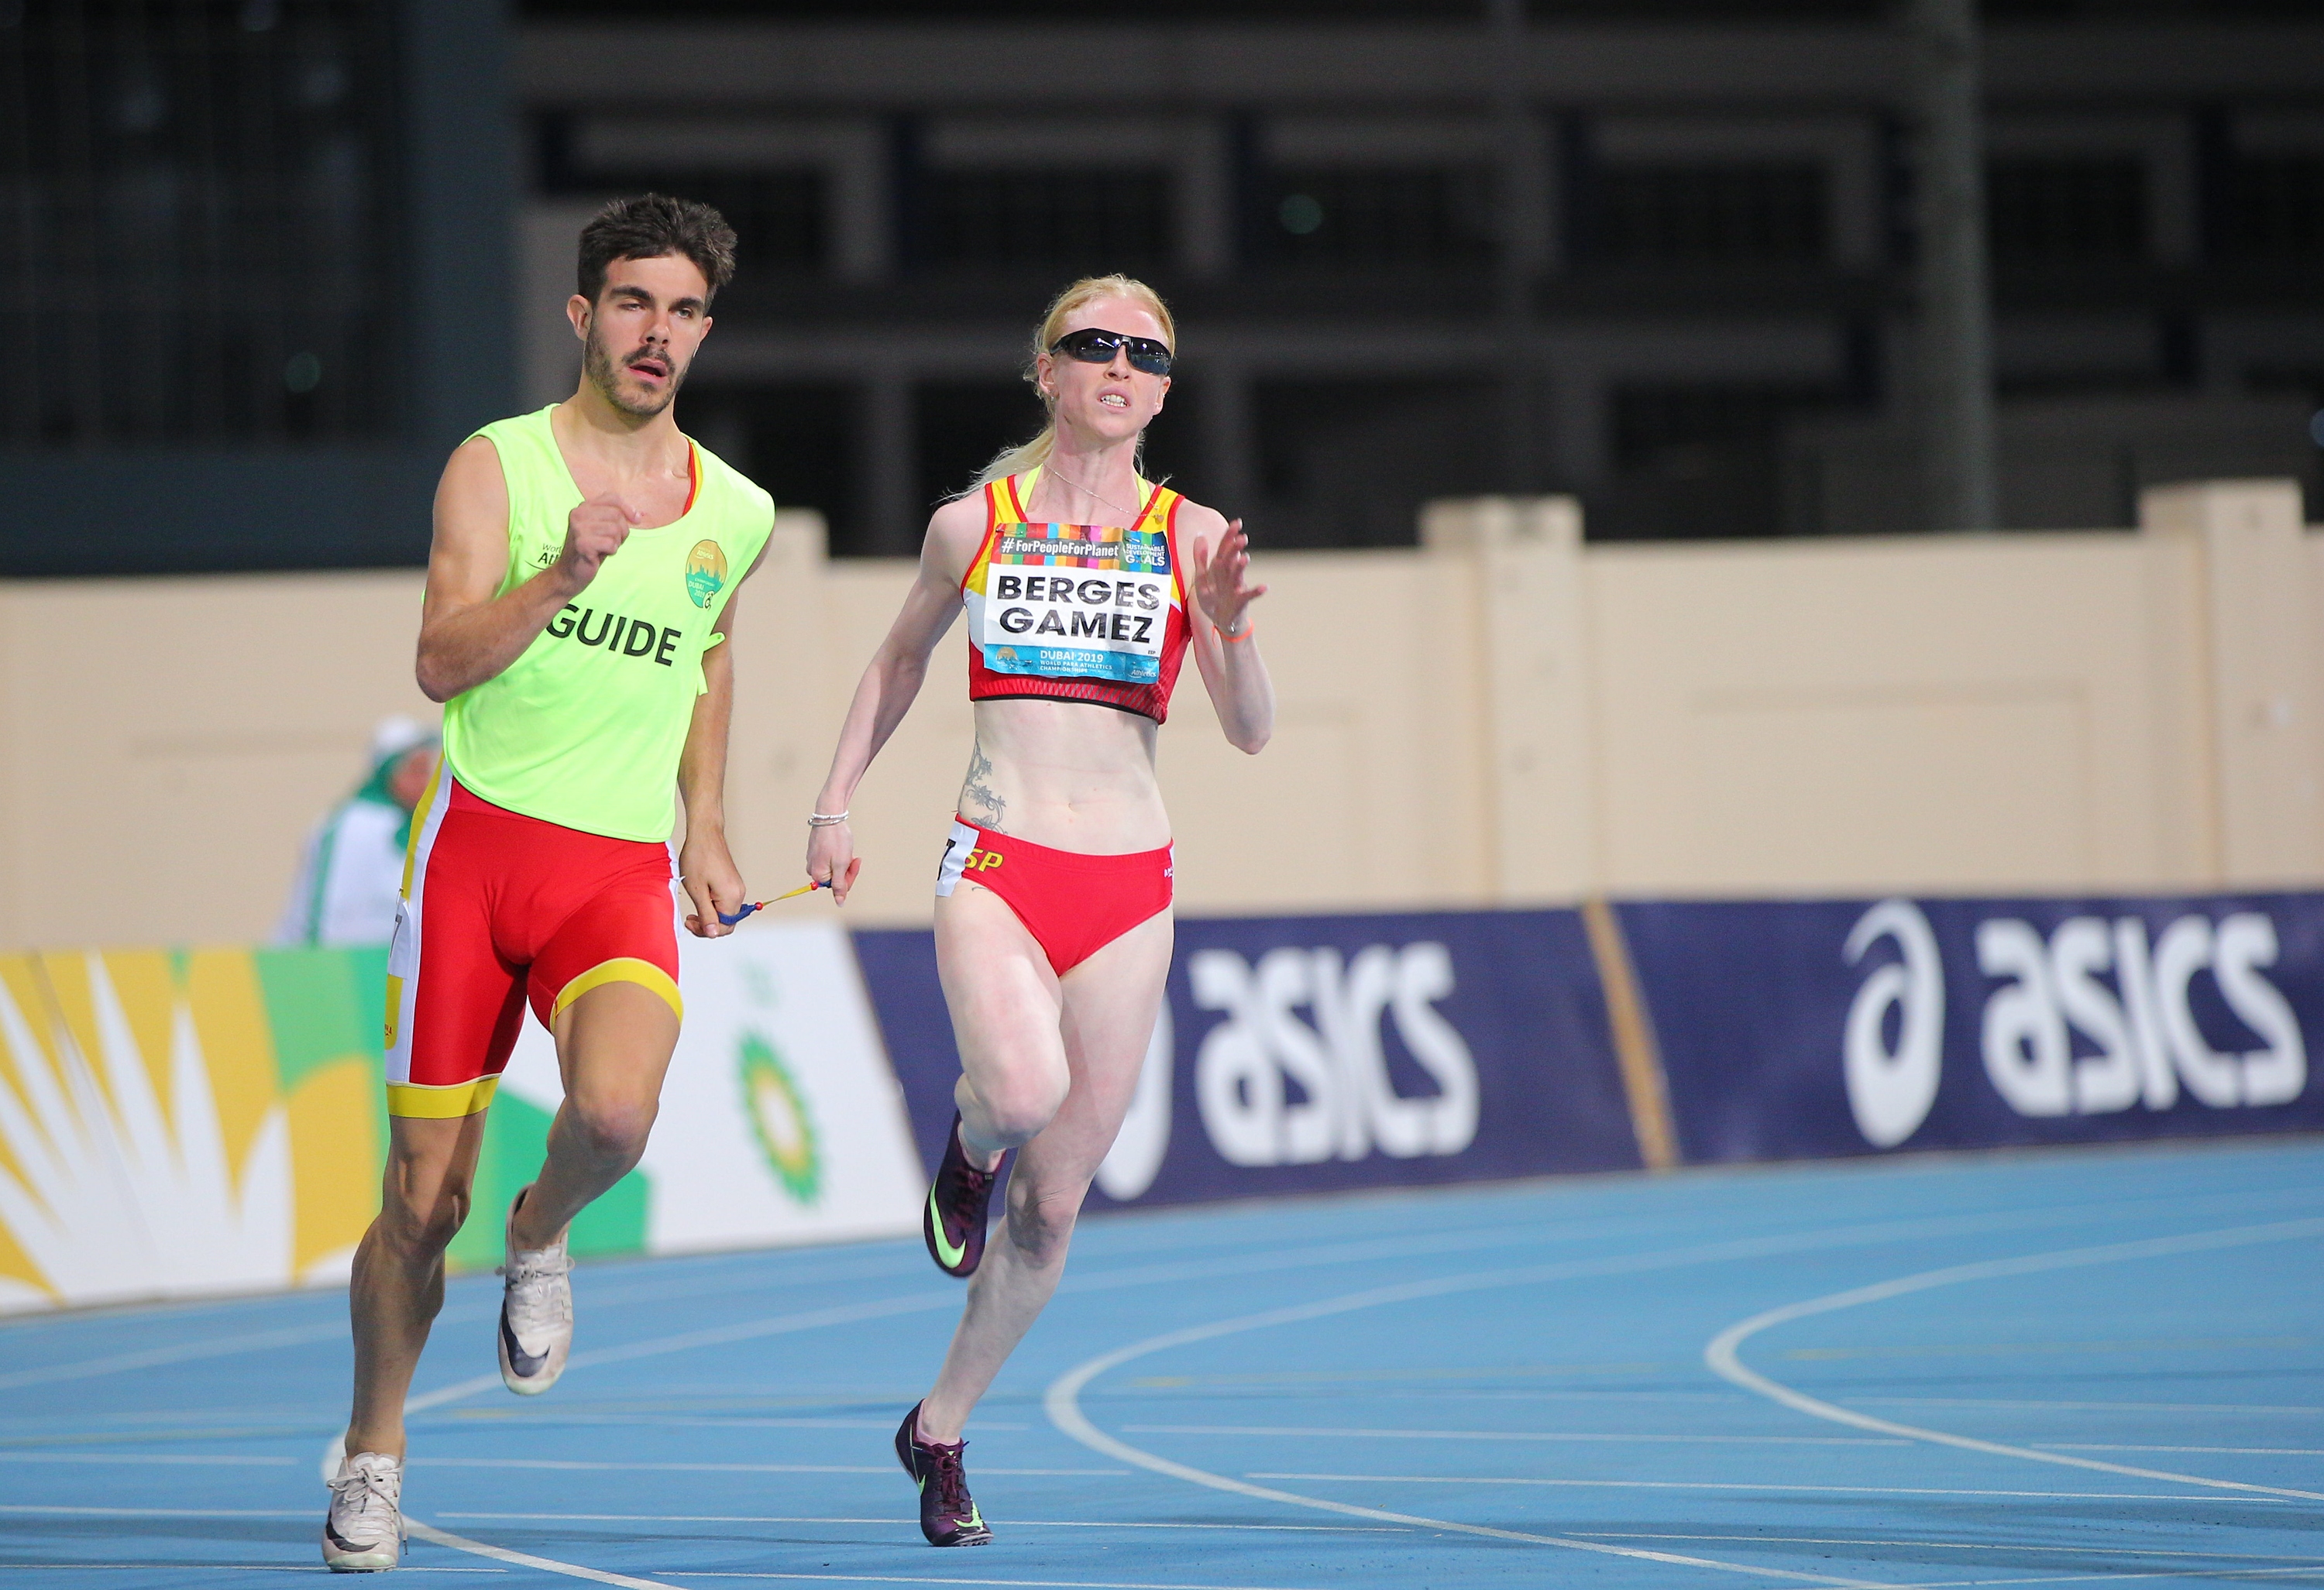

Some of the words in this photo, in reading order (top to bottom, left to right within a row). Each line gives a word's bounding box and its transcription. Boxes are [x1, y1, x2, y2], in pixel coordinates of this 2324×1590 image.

[1002, 537, 1119, 557] #ForPeopleForPlanet
[997, 575, 1160, 610] BERGES
[545, 603, 682, 667] GUIDE
[999, 607, 1153, 644] GAMEZ
[1040, 650, 1074, 661] DUBAI
[1077, 652, 1104, 663] 2019
[964, 847, 1004, 873] SP
[1975, 912, 2308, 1118] asics
[1188, 940, 1480, 1167] asics
